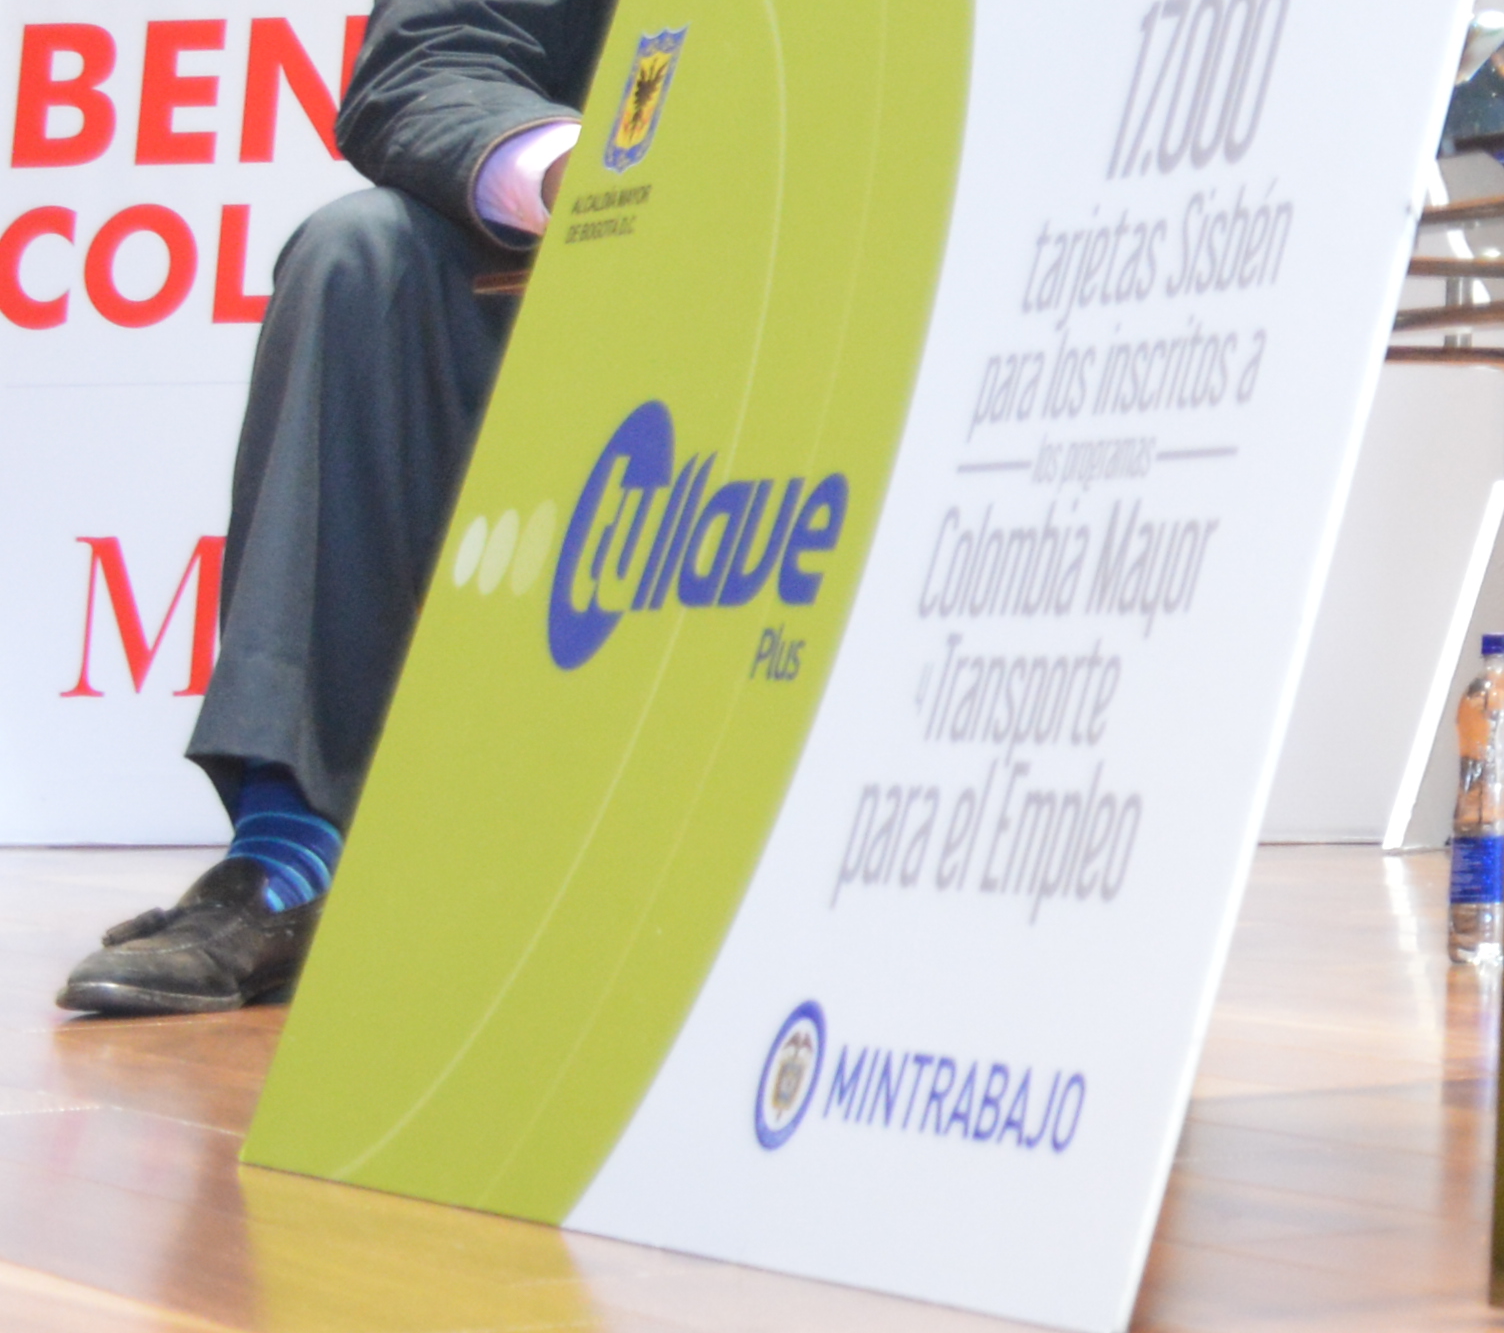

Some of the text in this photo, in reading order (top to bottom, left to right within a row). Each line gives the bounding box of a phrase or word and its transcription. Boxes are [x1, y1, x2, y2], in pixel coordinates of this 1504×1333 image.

[1021, 177, 1294, 332] tarjetas Sisbén
[968, 316, 1268, 437] para los inscritos a
[917, 497, 1221, 639] Colombia Mayor
[750, 623, 806, 681] Plus
[922, 631, 1123, 769] Transporte
[830, 758, 1144, 928] para el Empleo
[822, 1043, 1087, 1154] MINTRABAJO
